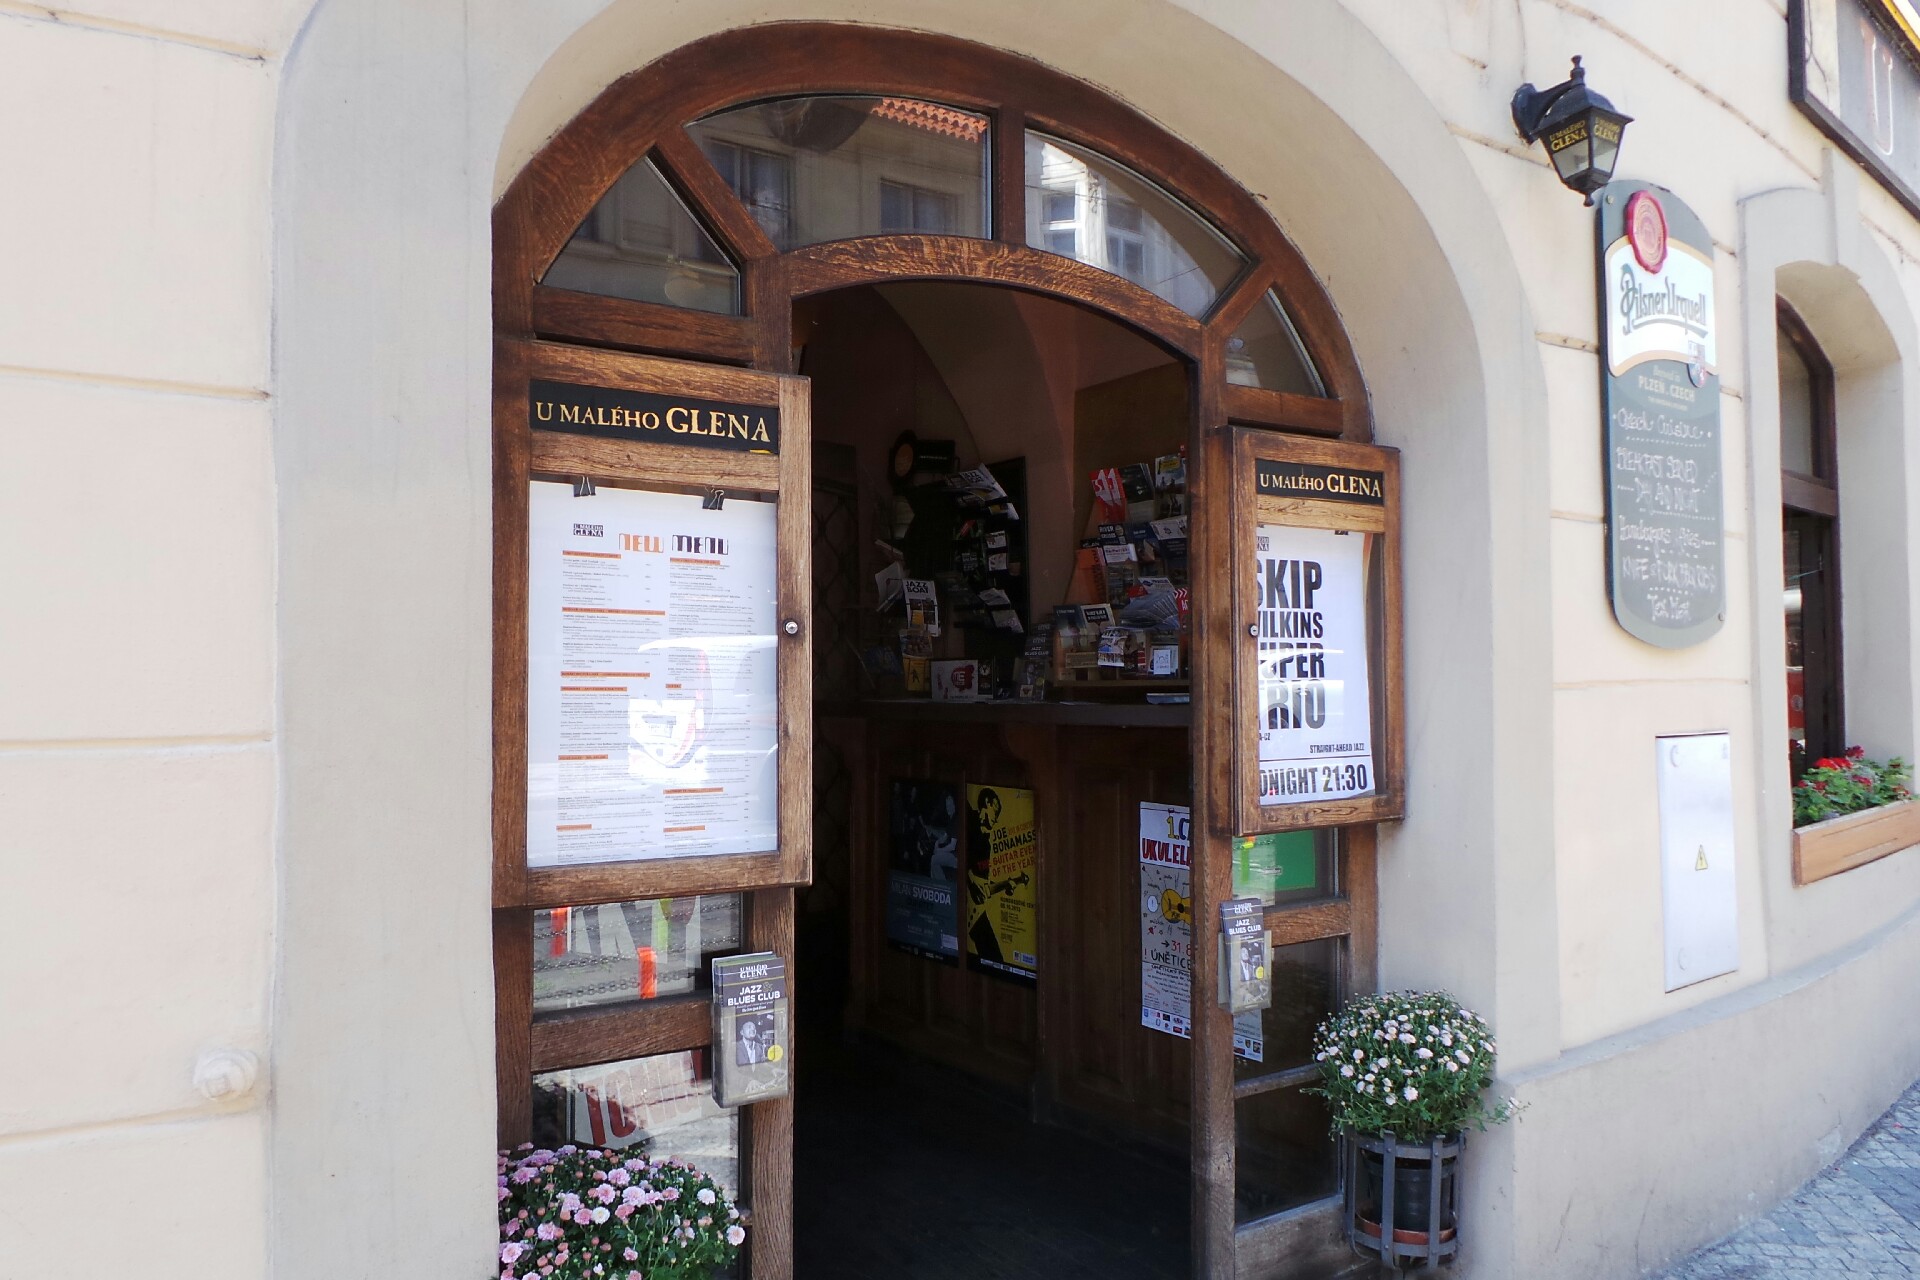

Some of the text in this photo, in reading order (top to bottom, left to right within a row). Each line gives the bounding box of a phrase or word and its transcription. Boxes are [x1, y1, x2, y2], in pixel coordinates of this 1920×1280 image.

[1551, 128, 1588, 151] GLENA
[1620, 262, 1707, 336] Pilsner Urquell
[536, 402, 770, 442] U MALÉHO GLENA
[1260, 473, 1382, 498] U MALÉHO GLENA
[573, 529, 604, 538] GLENA
[618, 533, 729, 556] NEW MENU
[905, 580, 928, 589] JAZZ
[907, 585, 930, 595] BOAT
[1258, 678, 1326, 730] RIO
[1259, 764, 1368, 798] ONIGHT 21:30
[993, 827, 1008, 842] JOE
[993, 850, 1019, 866] GUITAR
[1002, 862, 1017, 874] THE
[912, 886, 952, 906] SVOBODA
[1228, 924, 1262, 935] BLUES CLUB
[1235, 918, 1250, 927] JAZZ
[739, 969, 768, 979] GLENA
[739, 984, 763, 995] JAZZ
[727, 990, 781, 1006] BLUES CLUB
